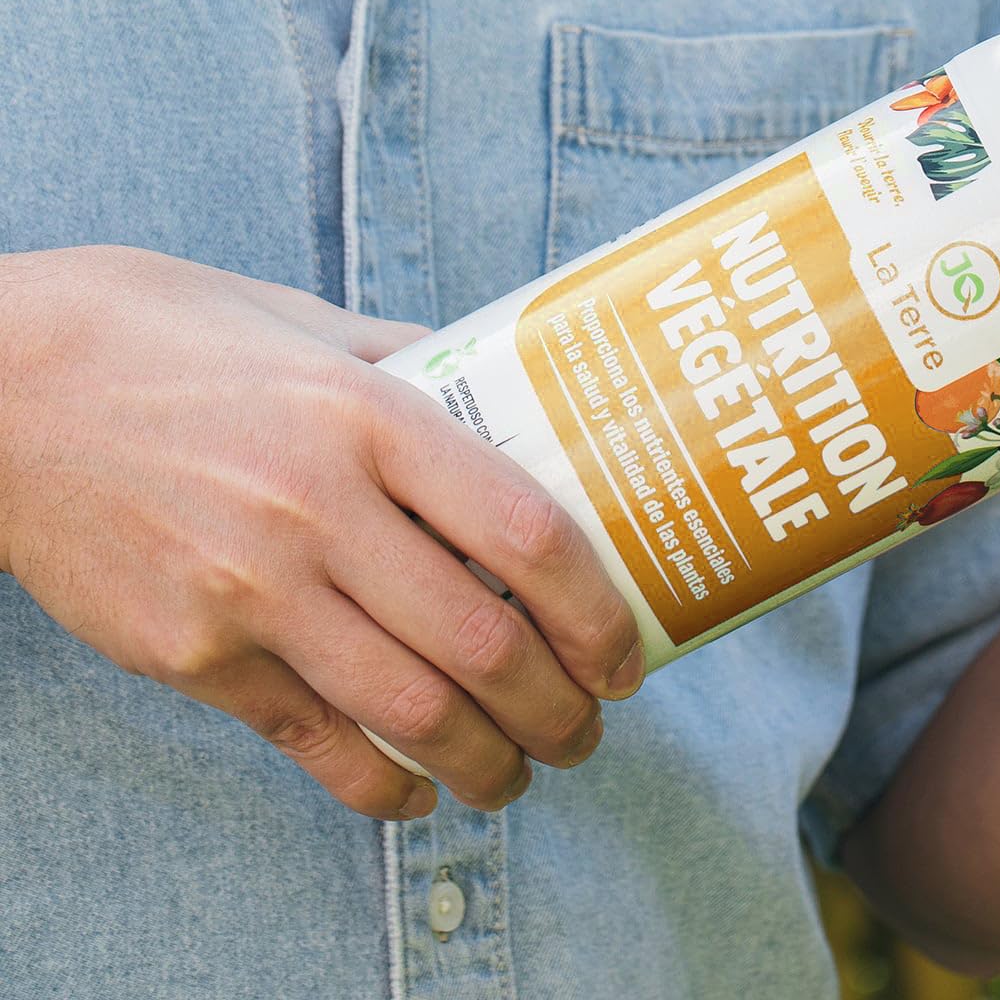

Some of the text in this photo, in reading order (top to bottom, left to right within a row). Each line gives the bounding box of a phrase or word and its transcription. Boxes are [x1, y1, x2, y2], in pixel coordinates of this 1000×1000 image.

[874, 155, 889, 168] la
[440, 384, 451, 396] LA
[455, 376, 484, 426] RESPETUOSO
[646, 259, 830, 542] VÉGÉTALE
[711, 210, 909, 514] NUTRITION
[867, 242, 943, 370] La Terre
[546, 312, 709, 600] para la salud y vitalidad de las plantas
[577, 296, 735, 584] Proporciona los nutrientes esenciales
